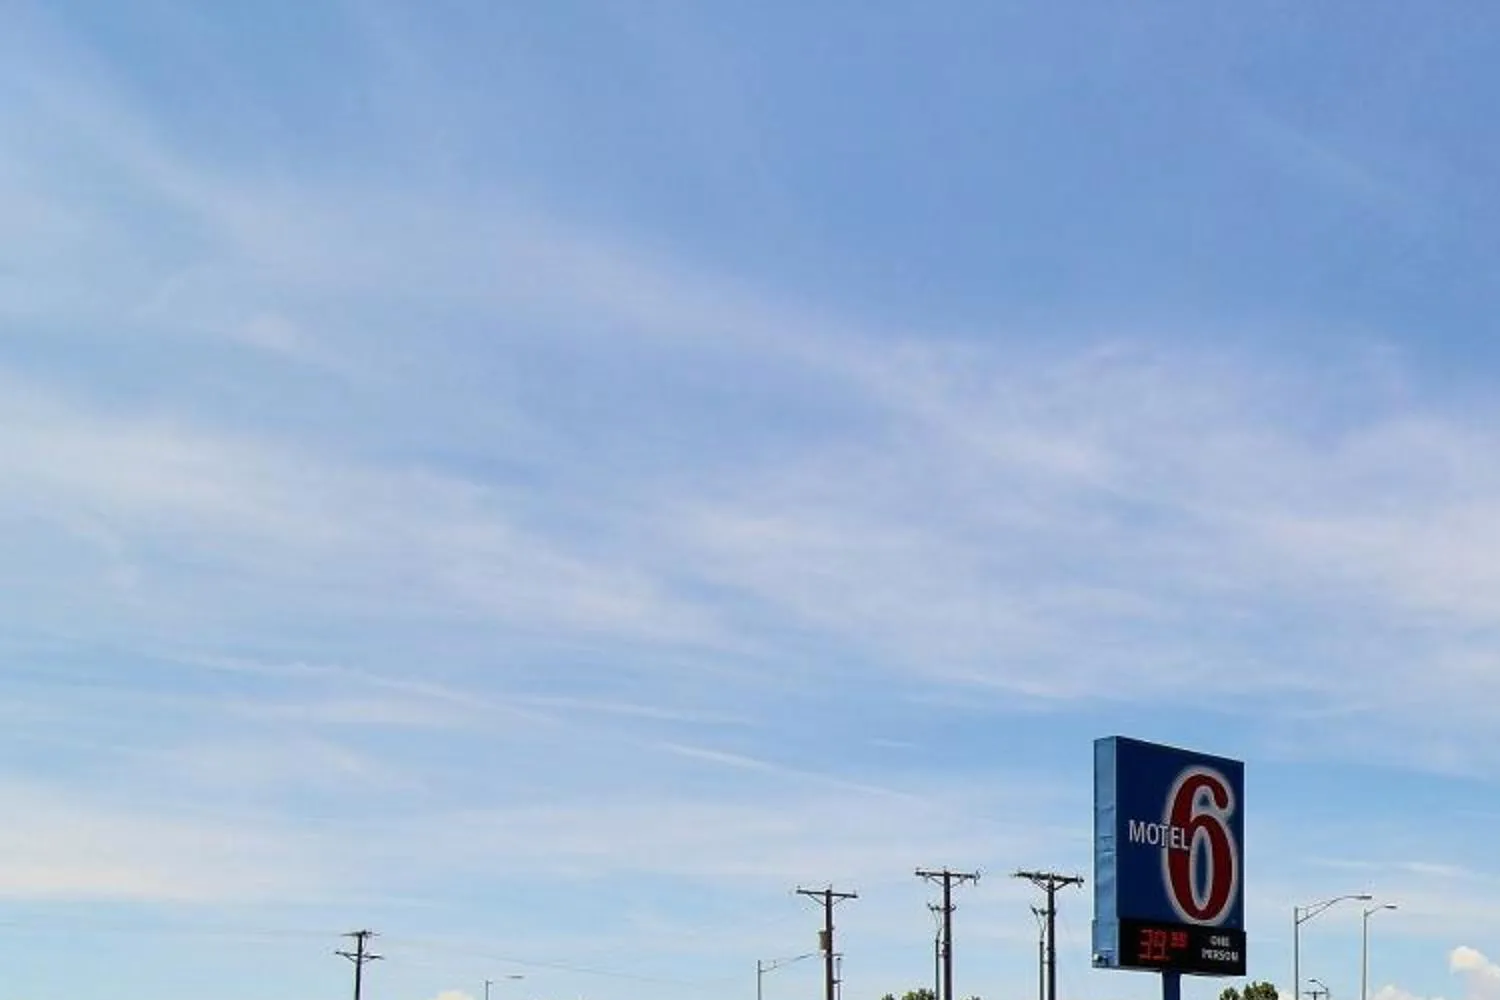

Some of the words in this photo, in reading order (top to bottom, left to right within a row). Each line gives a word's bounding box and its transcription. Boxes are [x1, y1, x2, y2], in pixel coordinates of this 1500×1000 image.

[1129, 819, 1189, 850] MOTEL
[1162, 766, 1238, 926] 6
[1201, 948, 1239, 962] PERSON
